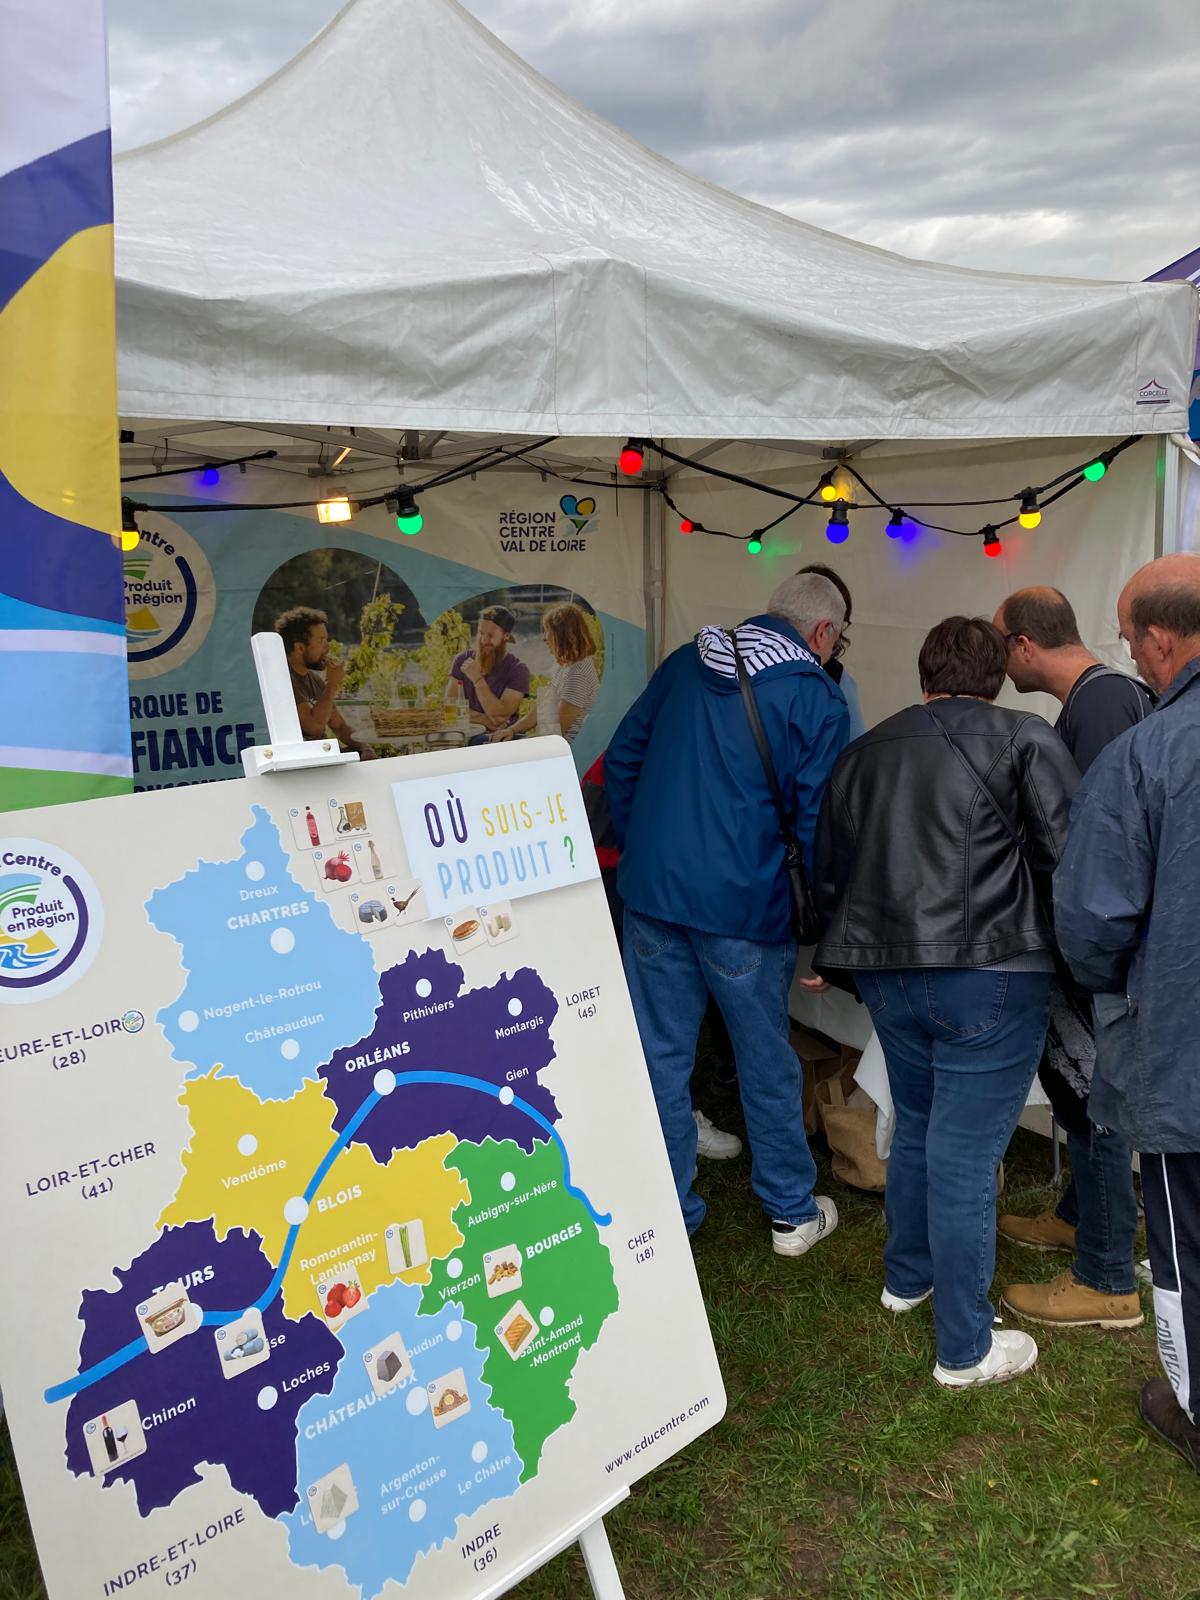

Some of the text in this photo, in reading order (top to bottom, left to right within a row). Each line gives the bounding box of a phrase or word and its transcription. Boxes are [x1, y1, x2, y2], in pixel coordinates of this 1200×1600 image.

[499, 509, 556, 524] RÉGION
[139, 529, 175, 555] ntre
[499, 526, 555, 538] CENTRE
[500, 539, 586, 552] VAL DE LOIRE
[133, 593, 183, 607] Région
[129, 691, 223, 719] RQUE DE
[131, 723, 256, 773] FIANCE
[424, 789, 568, 848] OÙ SUIS-JE
[2, 852, 62, 876] Centre
[437, 835, 575, 899] PRODUIT ?
[240, 885, 279, 901] Dreux
[7, 912, 75, 933] en Région
[12, 900, 64, 919] Produit
[227, 901, 310, 931] CHARTRES
[204, 980, 322, 1022] Nogent-le-Rotrou
[402, 999, 455, 1023] Pithiviers
[566, 986, 601, 1007] LOIRET
[577, 1004, 597, 1020] (45)
[244, 1012, 325, 1044] Châteaudun
[495, 1015, 545, 1040] Montargis
[52, 1049, 86, 1070] (28)
[345, 1041, 411, 1073] ORLÉANS
[506, 1066, 529, 1082] Gien
[26, 1142, 156, 1196] LOIR-ET-CHER
[221, 1159, 287, 1190] Vendôme
[81, 1177, 114, 1200] (41)
[316, 1184, 363, 1213] BLOIS
[467, 1179, 558, 1228] Aubigny-sur-Nère
[300, 1232, 378, 1271] Romorantin-
[525, 1222, 583, 1260] BOURGES
[627, 1229, 655, 1251] CHER
[310, 1249, 376, 1285] Lanthenay
[636, 1246, 654, 1264] (18)
[152, 1265, 215, 1294] URS
[438, 1273, 481, 1301] Vierzon
[407, 1334, 444, 1359] oudun
[529, 1332, 582, 1368] -Montrond
[282, 1362, 331, 1393] Loches
[142, 1397, 197, 1431] Chinon
[604, 1397, 709, 1474] www.cducentre.com
[380, 1455, 441, 1497] Argenton-
[457, 1455, 512, 1496] Le Châtre
[381, 1468, 447, 1515] sur-Creuse
[103, 1508, 246, 1597] INDRE-ET-LOIRE
[461, 1523, 502, 1559] INDRE
[165, 1558, 197, 1587] (37)
[474, 1546, 498, 1572] (36)
